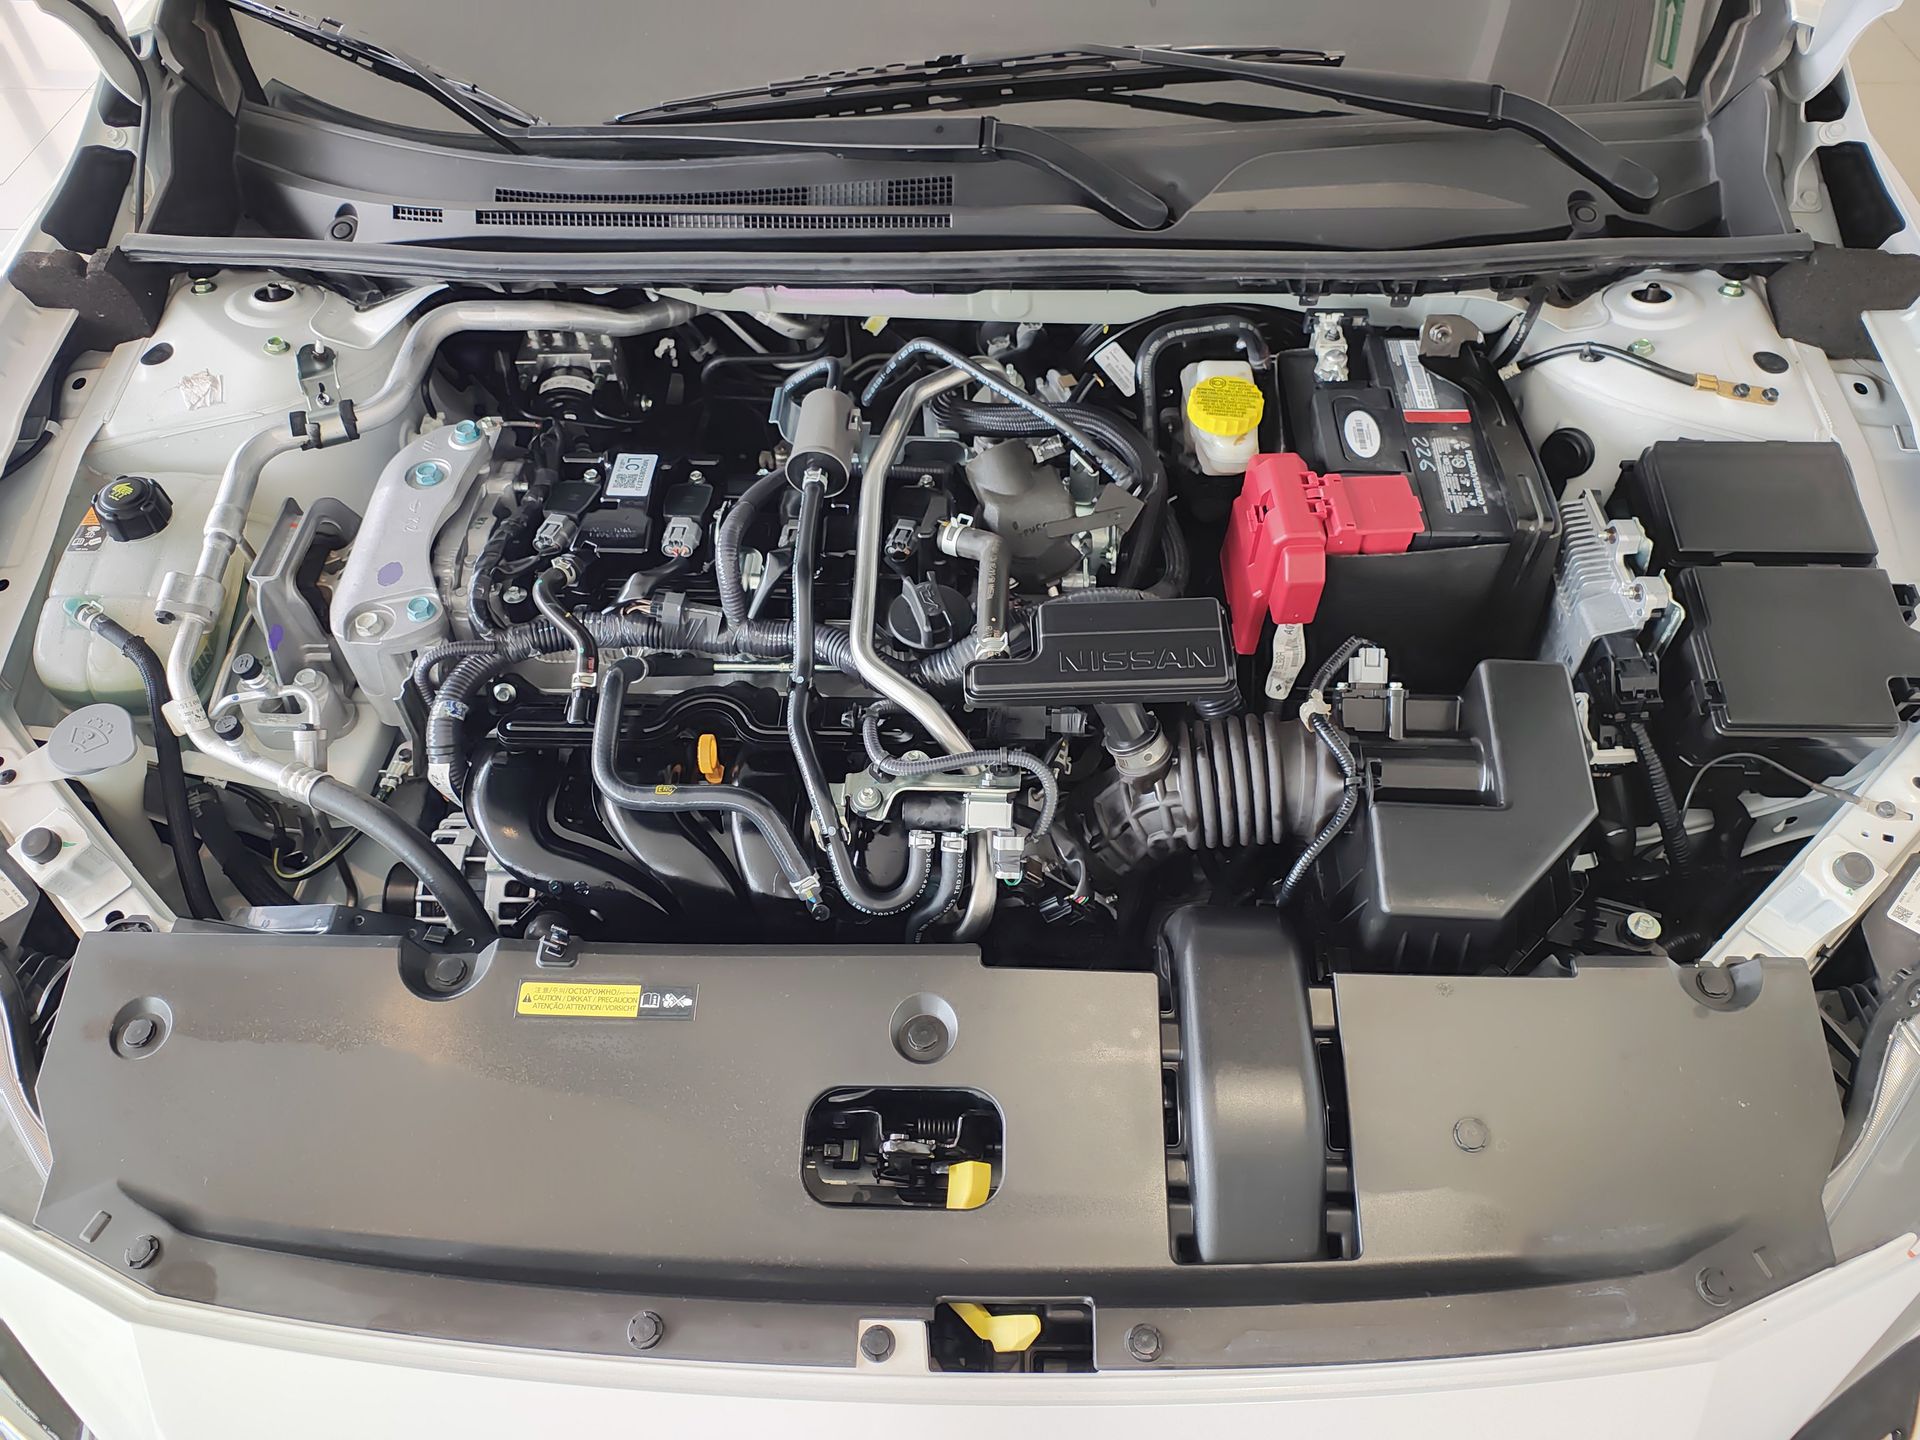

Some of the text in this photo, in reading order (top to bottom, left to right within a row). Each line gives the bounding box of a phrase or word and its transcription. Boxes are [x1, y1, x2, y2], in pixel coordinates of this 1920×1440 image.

[625, 458, 642, 470] LC
[1411, 437, 1436, 472] 226
[1059, 647, 1217, 672] NISSAN
